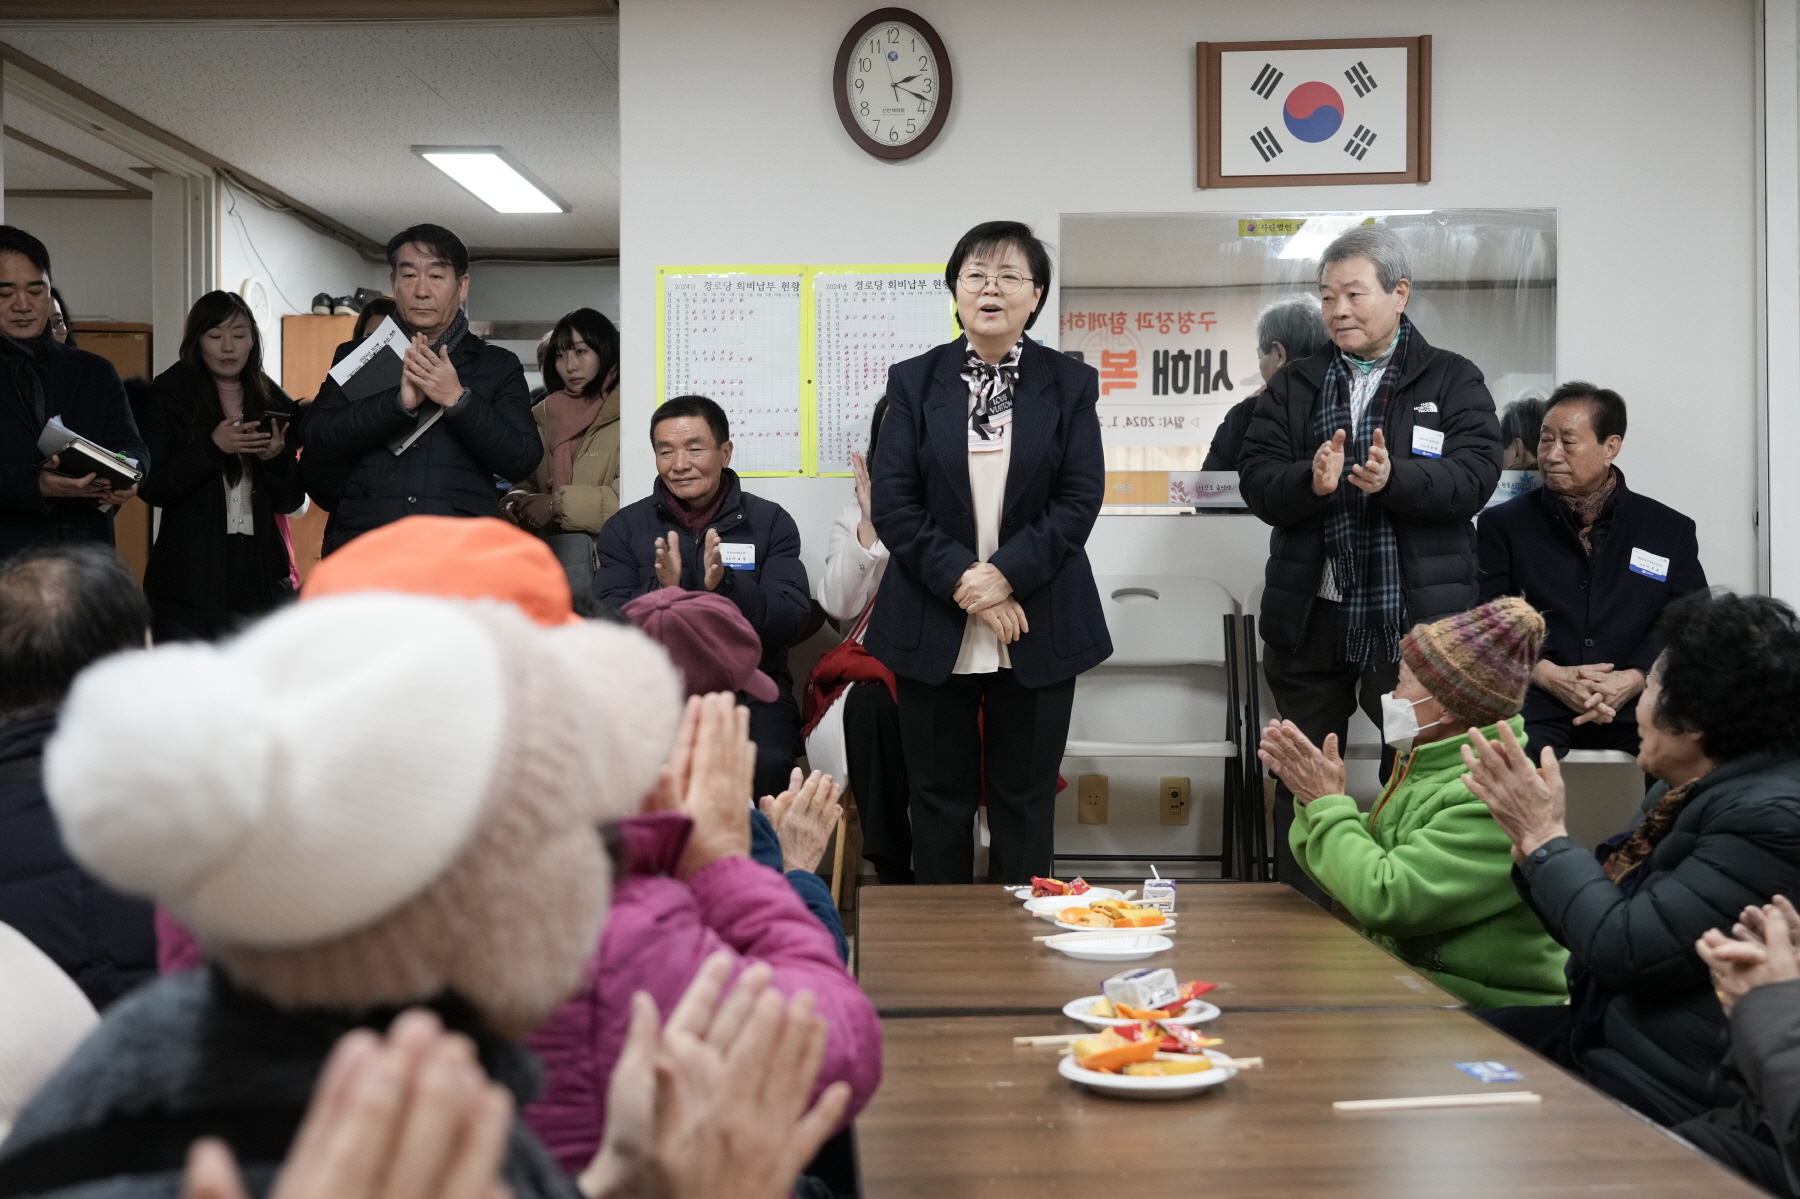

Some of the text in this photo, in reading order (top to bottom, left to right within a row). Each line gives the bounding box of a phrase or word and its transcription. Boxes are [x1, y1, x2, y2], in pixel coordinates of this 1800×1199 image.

[886, 28, 900, 43] 12
[870, 39, 880, 54] 11
[858, 58, 871, 72] 10
[919, 56, 927, 71] 2
[854, 78, 864, 94] 9
[923, 78, 932, 93] 3
[860, 101, 869, 116] 8
[917, 100, 927, 114] 4
[872, 120, 880, 134] 7
[906, 119, 916, 134] 5
[889, 126, 898, 142] 6
[1260, 223, 1292, 232] 사단법인
[703, 281, 732, 292] 경로당
[736, 281, 776, 292] 회비납부
[782, 281, 800, 292] 현황
[855, 280, 884, 291] 경로당
[888, 279, 927, 290] 회비납부
[992, 393, 1007, 406] LOUIS
[989, 400, 1012, 414] VUITTON
